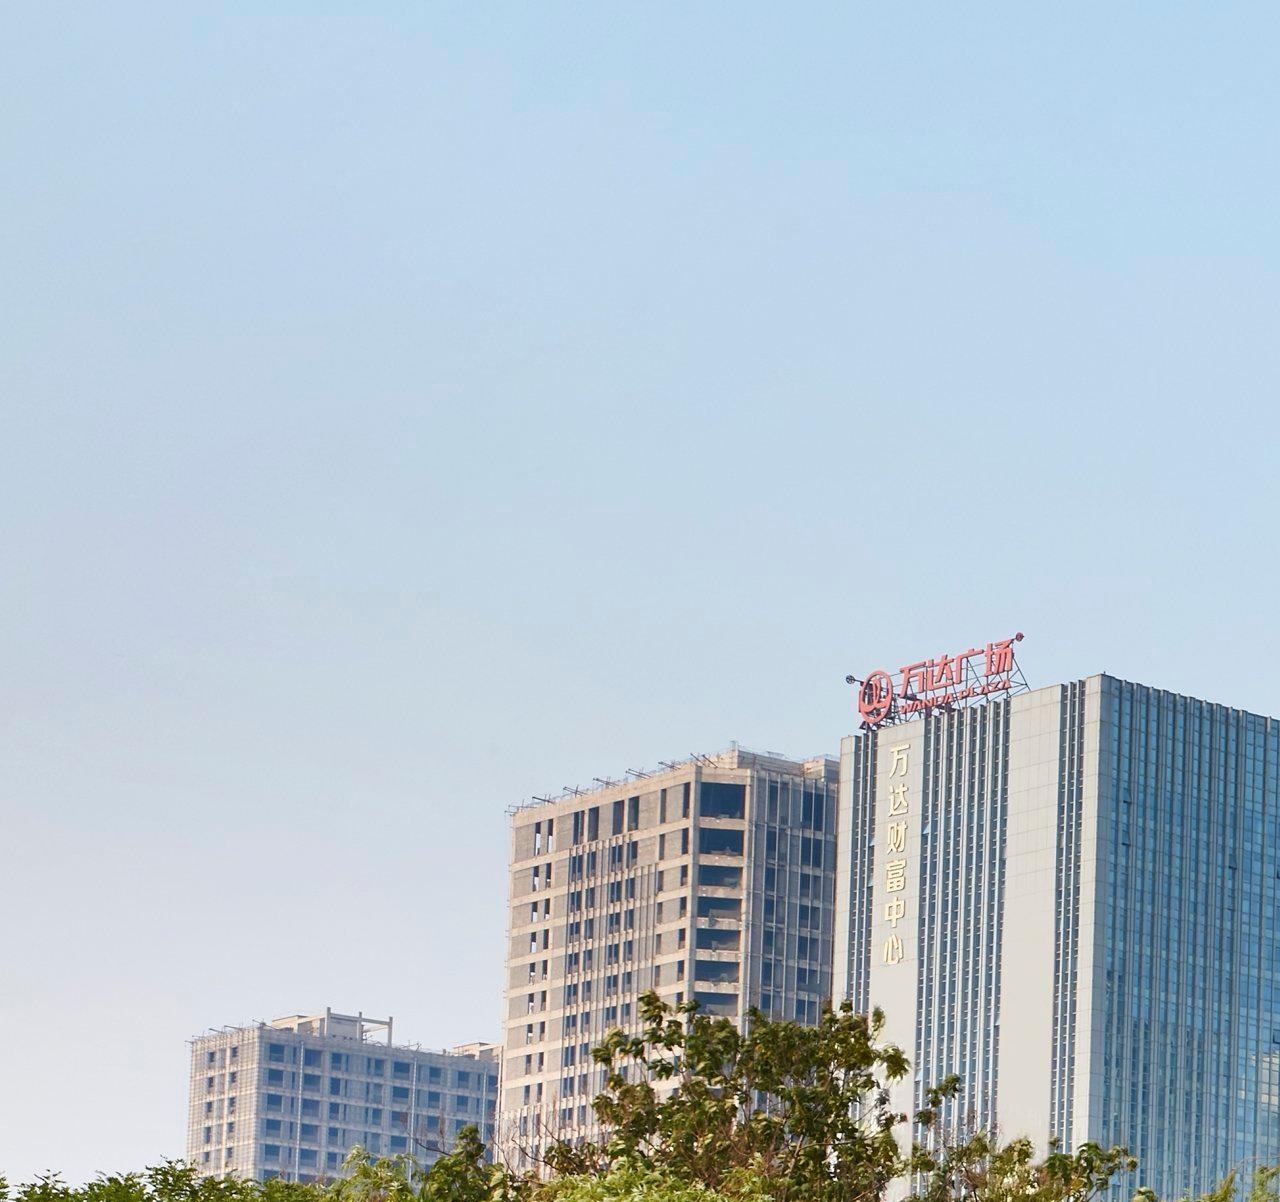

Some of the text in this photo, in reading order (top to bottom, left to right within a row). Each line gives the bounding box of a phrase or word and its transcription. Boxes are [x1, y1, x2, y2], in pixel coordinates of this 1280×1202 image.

[899, 639, 1013, 699] 万达广场
[899, 679, 1012, 715] WANDA PLAZA
[884, 744, 910, 965] 万达财富中心
